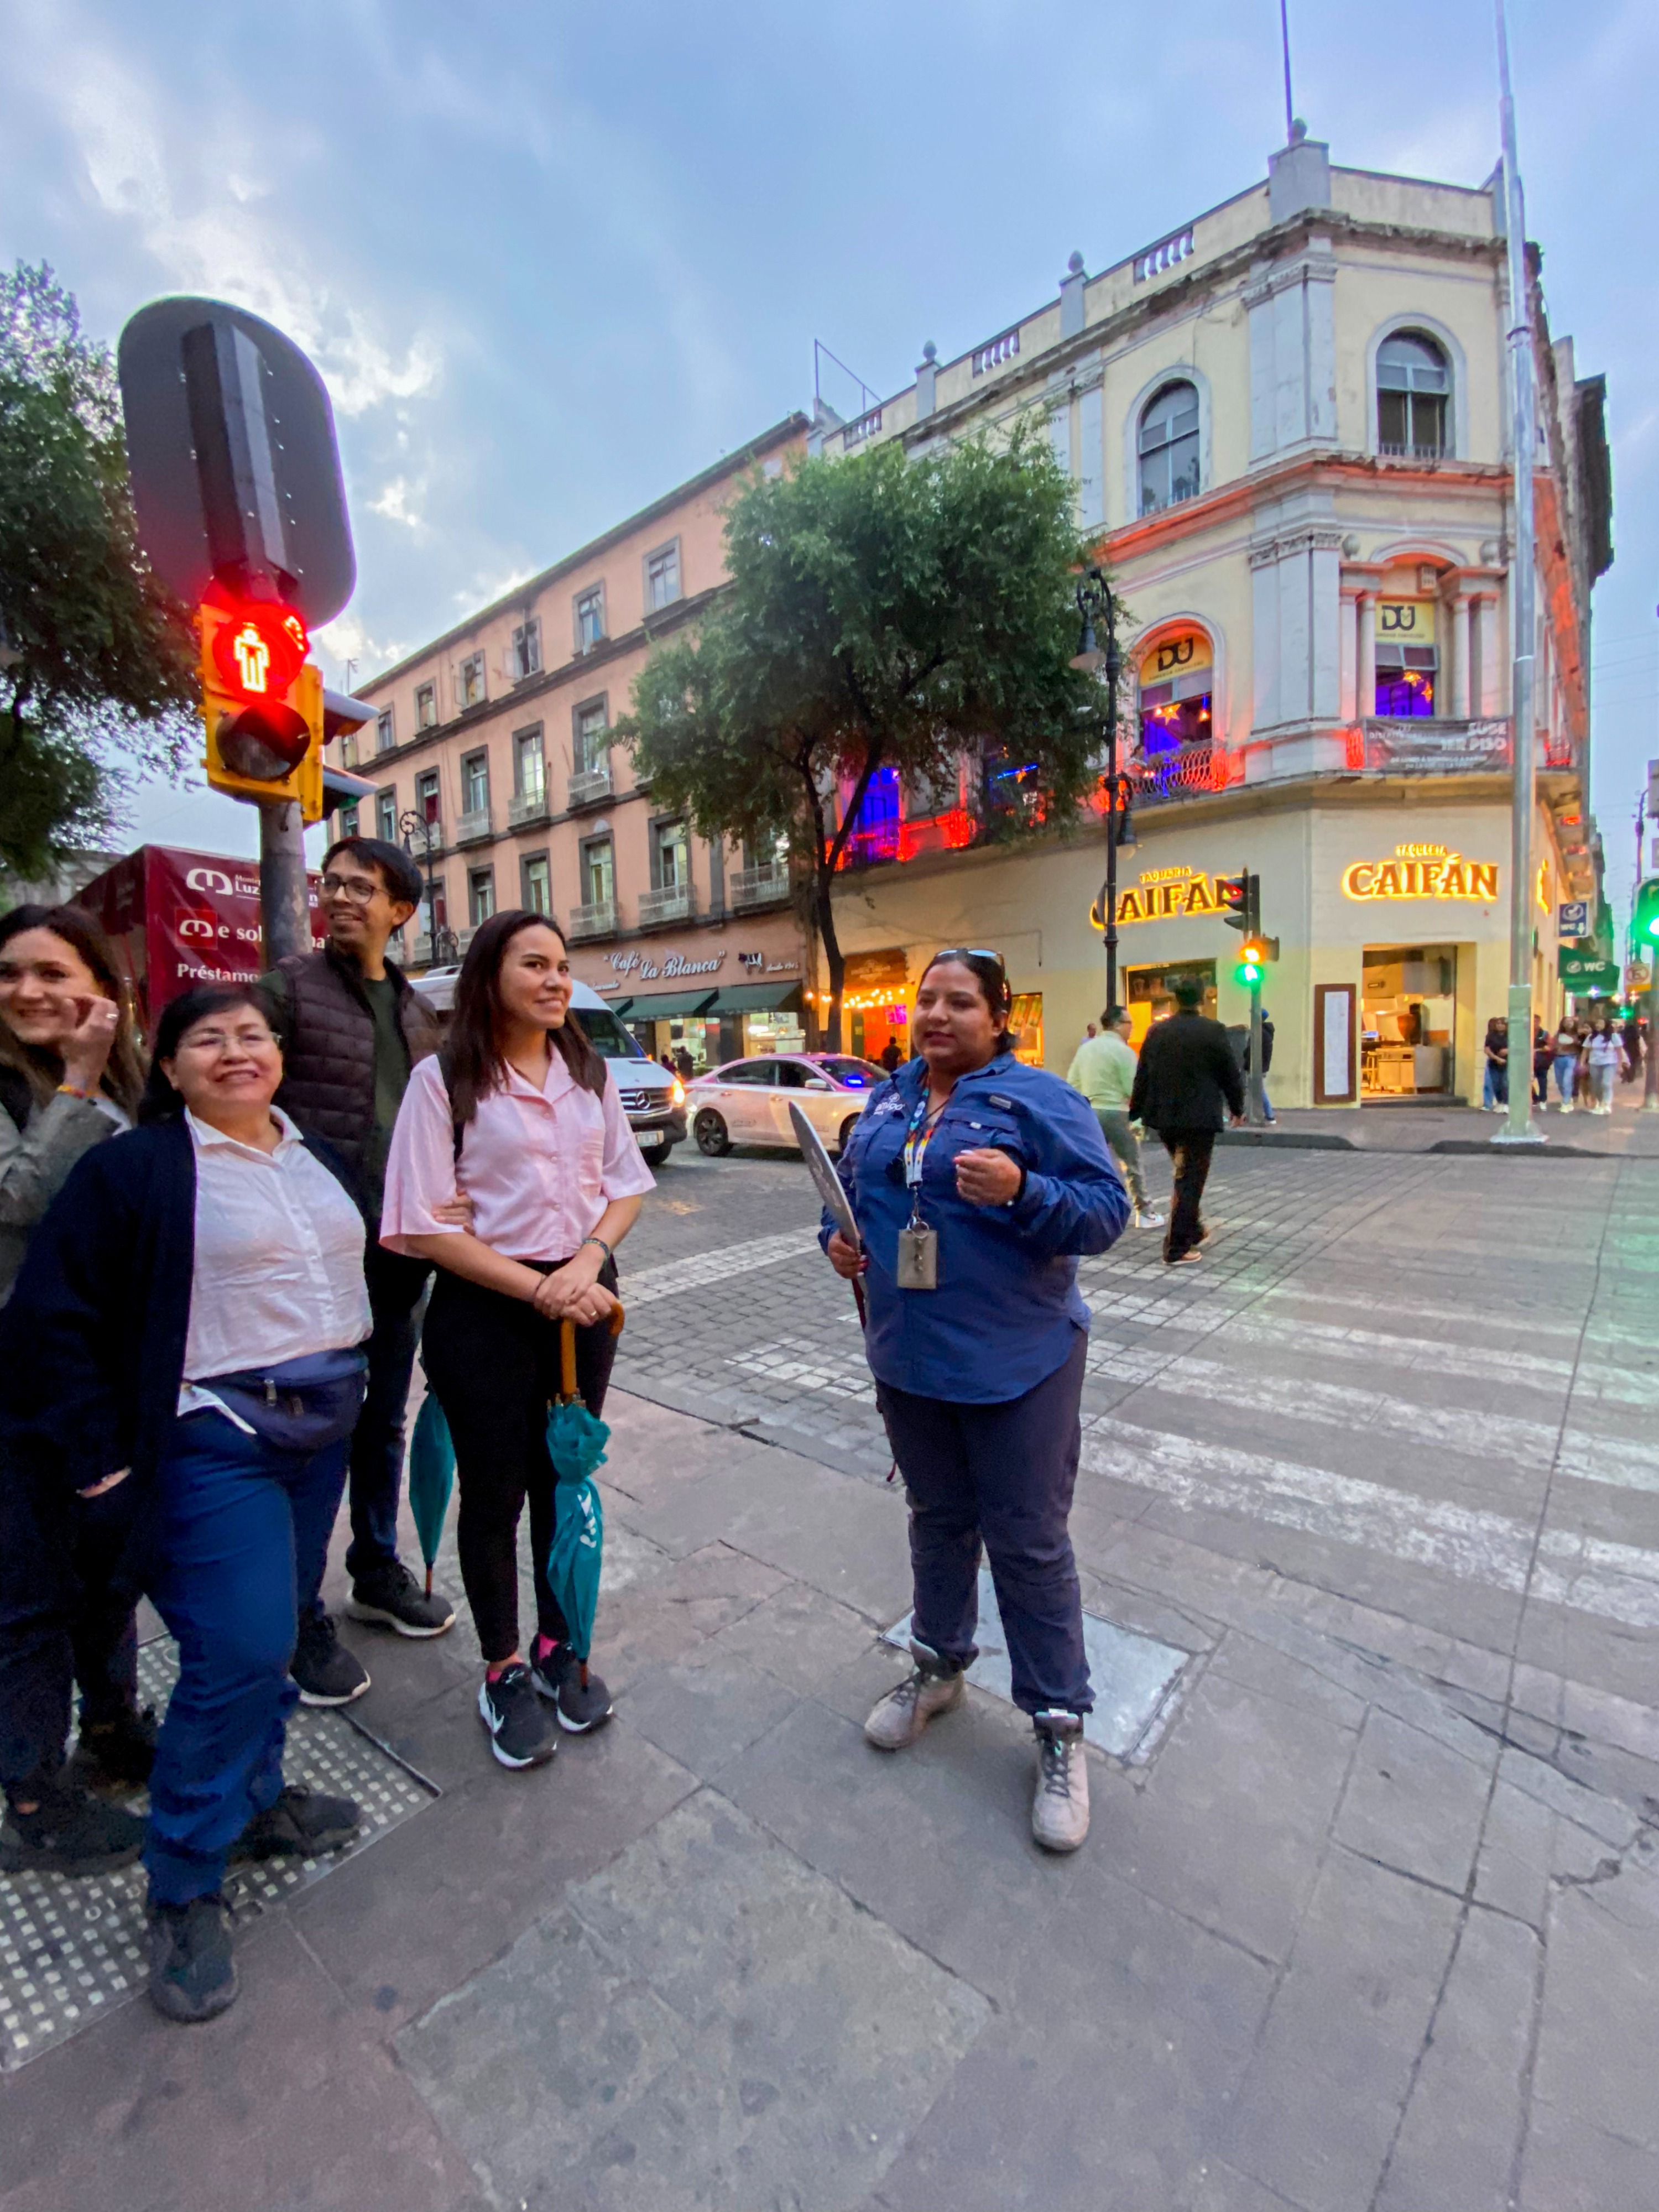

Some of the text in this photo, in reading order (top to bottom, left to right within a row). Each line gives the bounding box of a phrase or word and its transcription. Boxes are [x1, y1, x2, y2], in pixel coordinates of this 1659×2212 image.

[1469, 737, 1507, 751] PISO
[1344, 853, 1499, 901] CAIFÁN
[177, 963, 260, 983] Préstamo
[640, 960, 659, 980] La
[1584, 961, 1606, 972] WC
